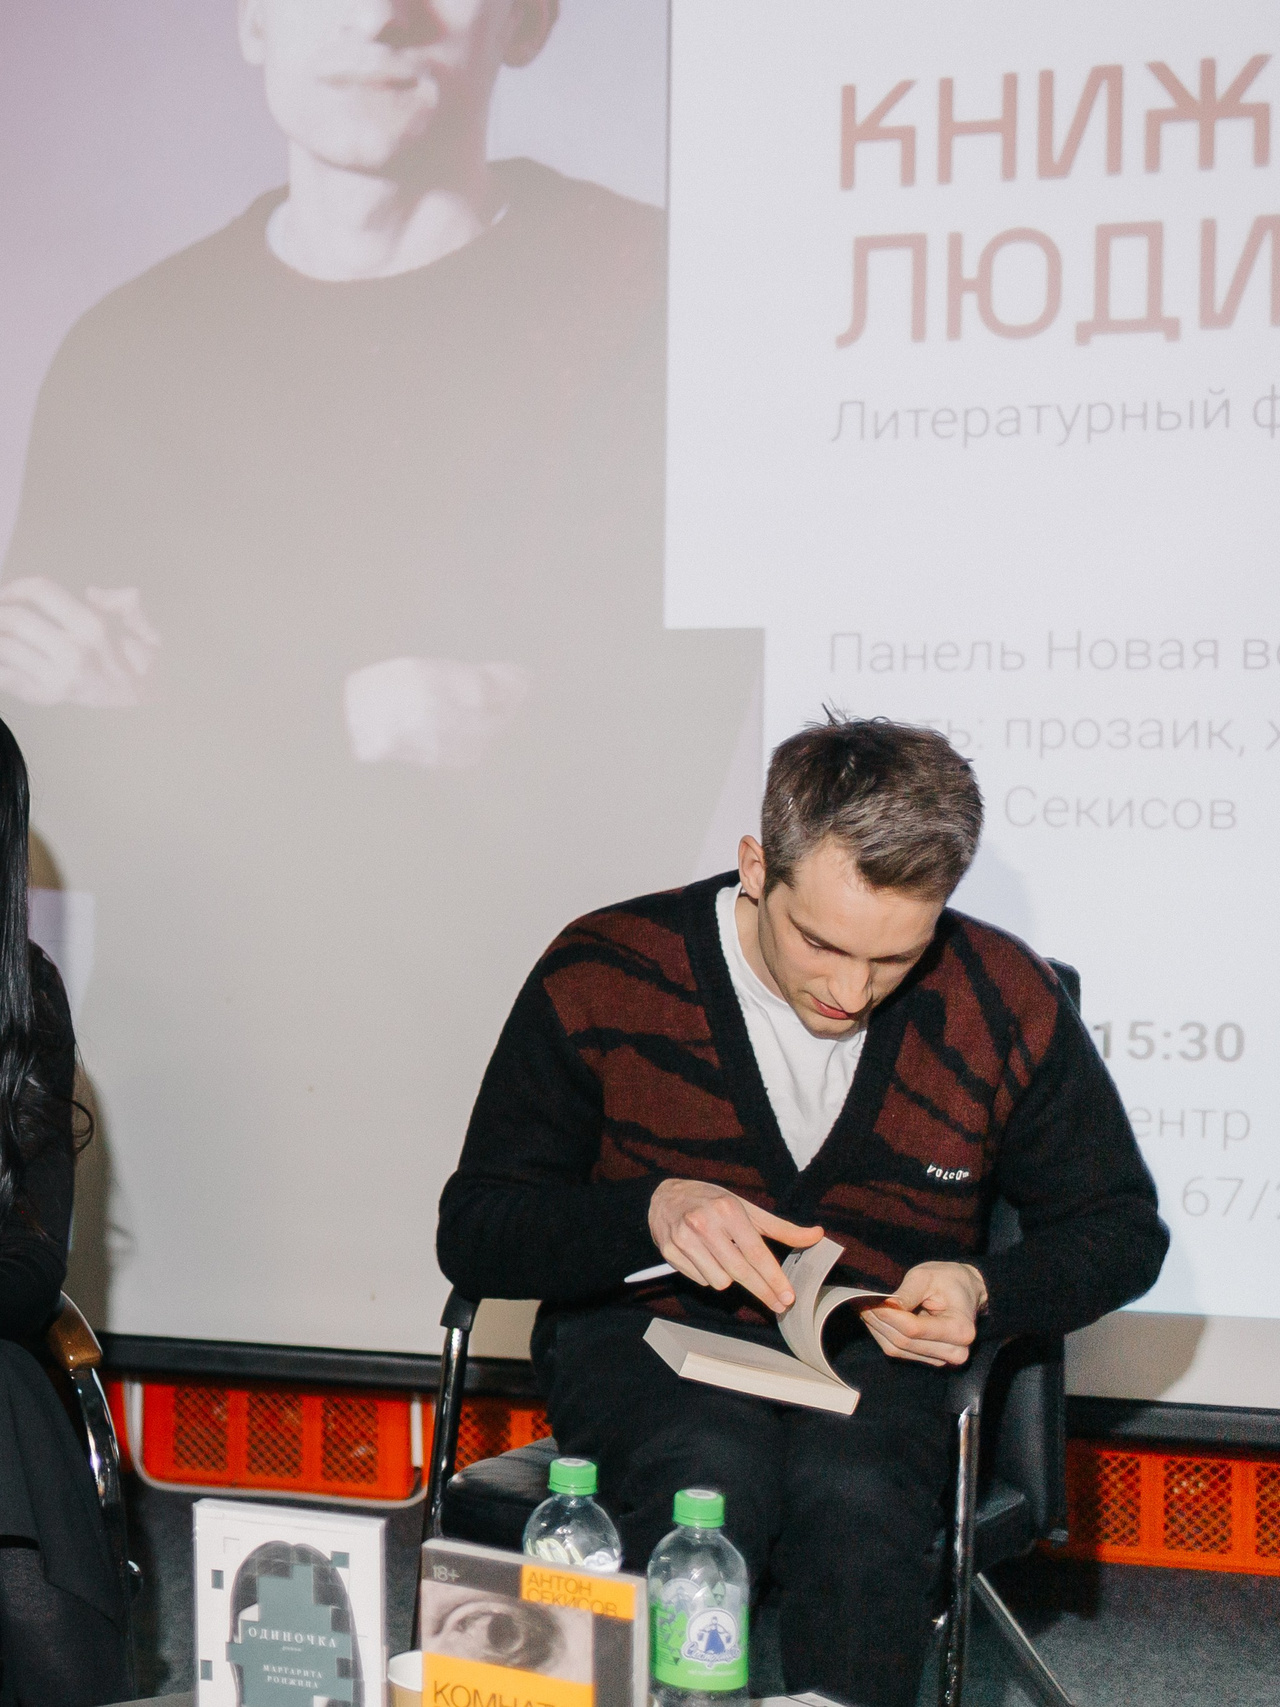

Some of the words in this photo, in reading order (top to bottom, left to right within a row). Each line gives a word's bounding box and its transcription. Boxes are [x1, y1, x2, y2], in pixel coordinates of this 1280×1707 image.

[840, 53, 1274, 191] КНИЖ
[835, 213, 1280, 349] ЛЮДИ
[831, 386, 1231, 449] Литературный
[828, 631, 1026, 674] Панель
[1046, 629, 1219, 671] Новая
[1243, 637, 1280, 671] в
[1004, 716, 1244, 760] прозаик,
[1004, 785, 1237, 831] Секисов
[1092, 1020, 1246, 1063] 15:30
[1128, 1106, 1251, 1151] ентр
[1181, 1175, 1280, 1222] 67/
[431, 1564, 460, 1583] 18+
[527, 1571, 592, 1597] АНТОН
[526, 1586, 618, 1617] СЕКИСОВ
[248, 1626, 337, 1649] ОДИНОЧКА
[262, 1663, 323, 1680] МАРГАРИТА
